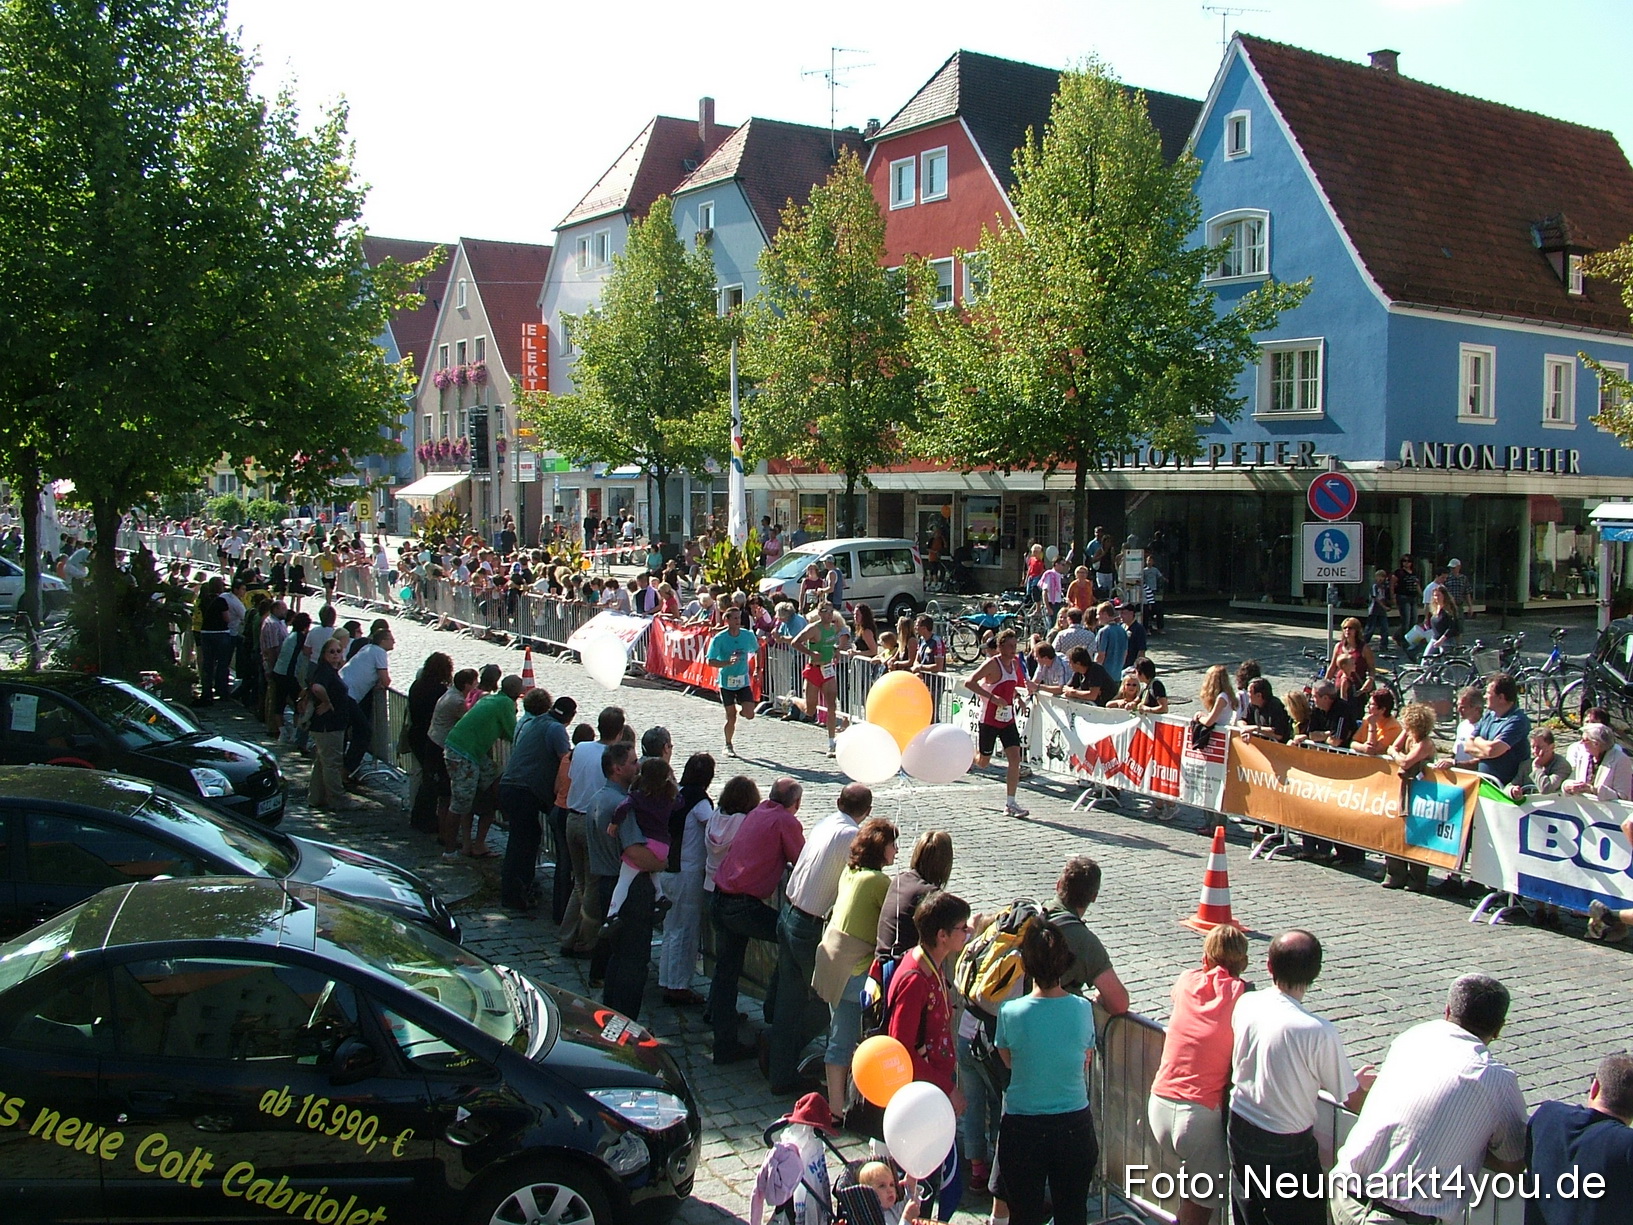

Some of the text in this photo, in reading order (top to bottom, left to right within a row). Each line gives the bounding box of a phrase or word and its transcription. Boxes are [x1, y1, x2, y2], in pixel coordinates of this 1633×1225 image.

[1209, 441, 1318, 468] PETER
[1400, 440, 1580, 474] ANTON PETER
[1316, 567, 1347, 577] ZONE
[1150, 759, 1178, 783] Braun
[1236, 765, 1398, 819] www.maxi-dsl.de
[1412, 794, 1451, 822] maxi
[1436, 821, 1455, 840] dsl
[258, 1085, 415, 1157] ab 16.990,- €
[28, 1107, 125, 1160] neue
[135, 1132, 214, 1188] Colt
[222, 1160, 388, 1225] Cabriolet
